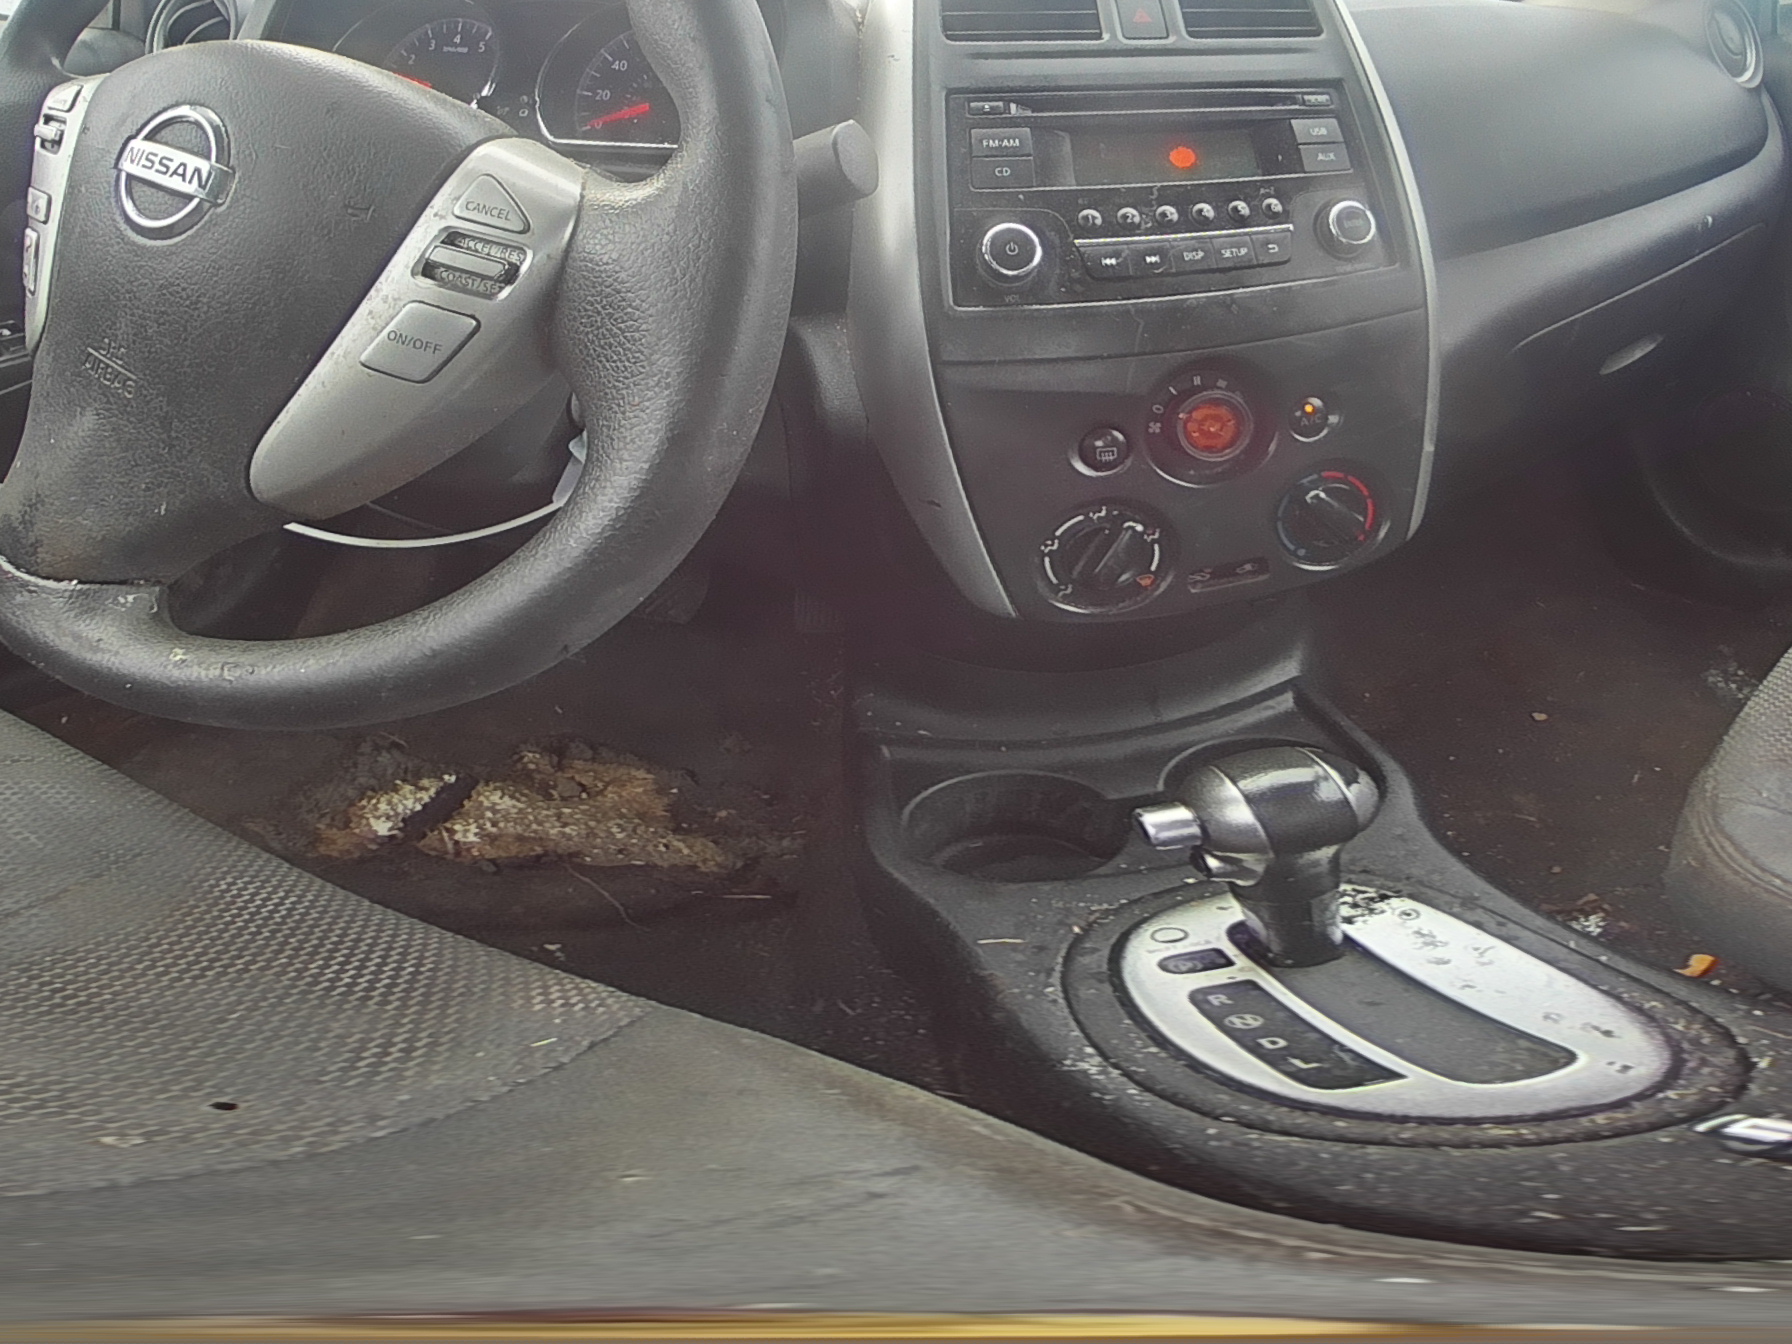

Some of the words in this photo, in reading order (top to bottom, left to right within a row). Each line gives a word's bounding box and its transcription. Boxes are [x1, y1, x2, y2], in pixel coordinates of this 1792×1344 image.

[428, 39, 436, 51] 3
[478, 41, 486, 53] 5
[408, 54, 416, 65] 2
[611, 59, 628, 72] 40
[595, 89, 611, 101] 20
[124, 146, 212, 191] NISSAN
[994, 167, 1011, 177] CD
[465, 200, 512, 222] CANCEL
[1220, 247, 1248, 258] SETUP
[387, 329, 443, 355] ON/OFF
[1208, 993, 1234, 1006] R
[1256, 1036, 1289, 1050] D
[1285, 1056, 1322, 1069] L
